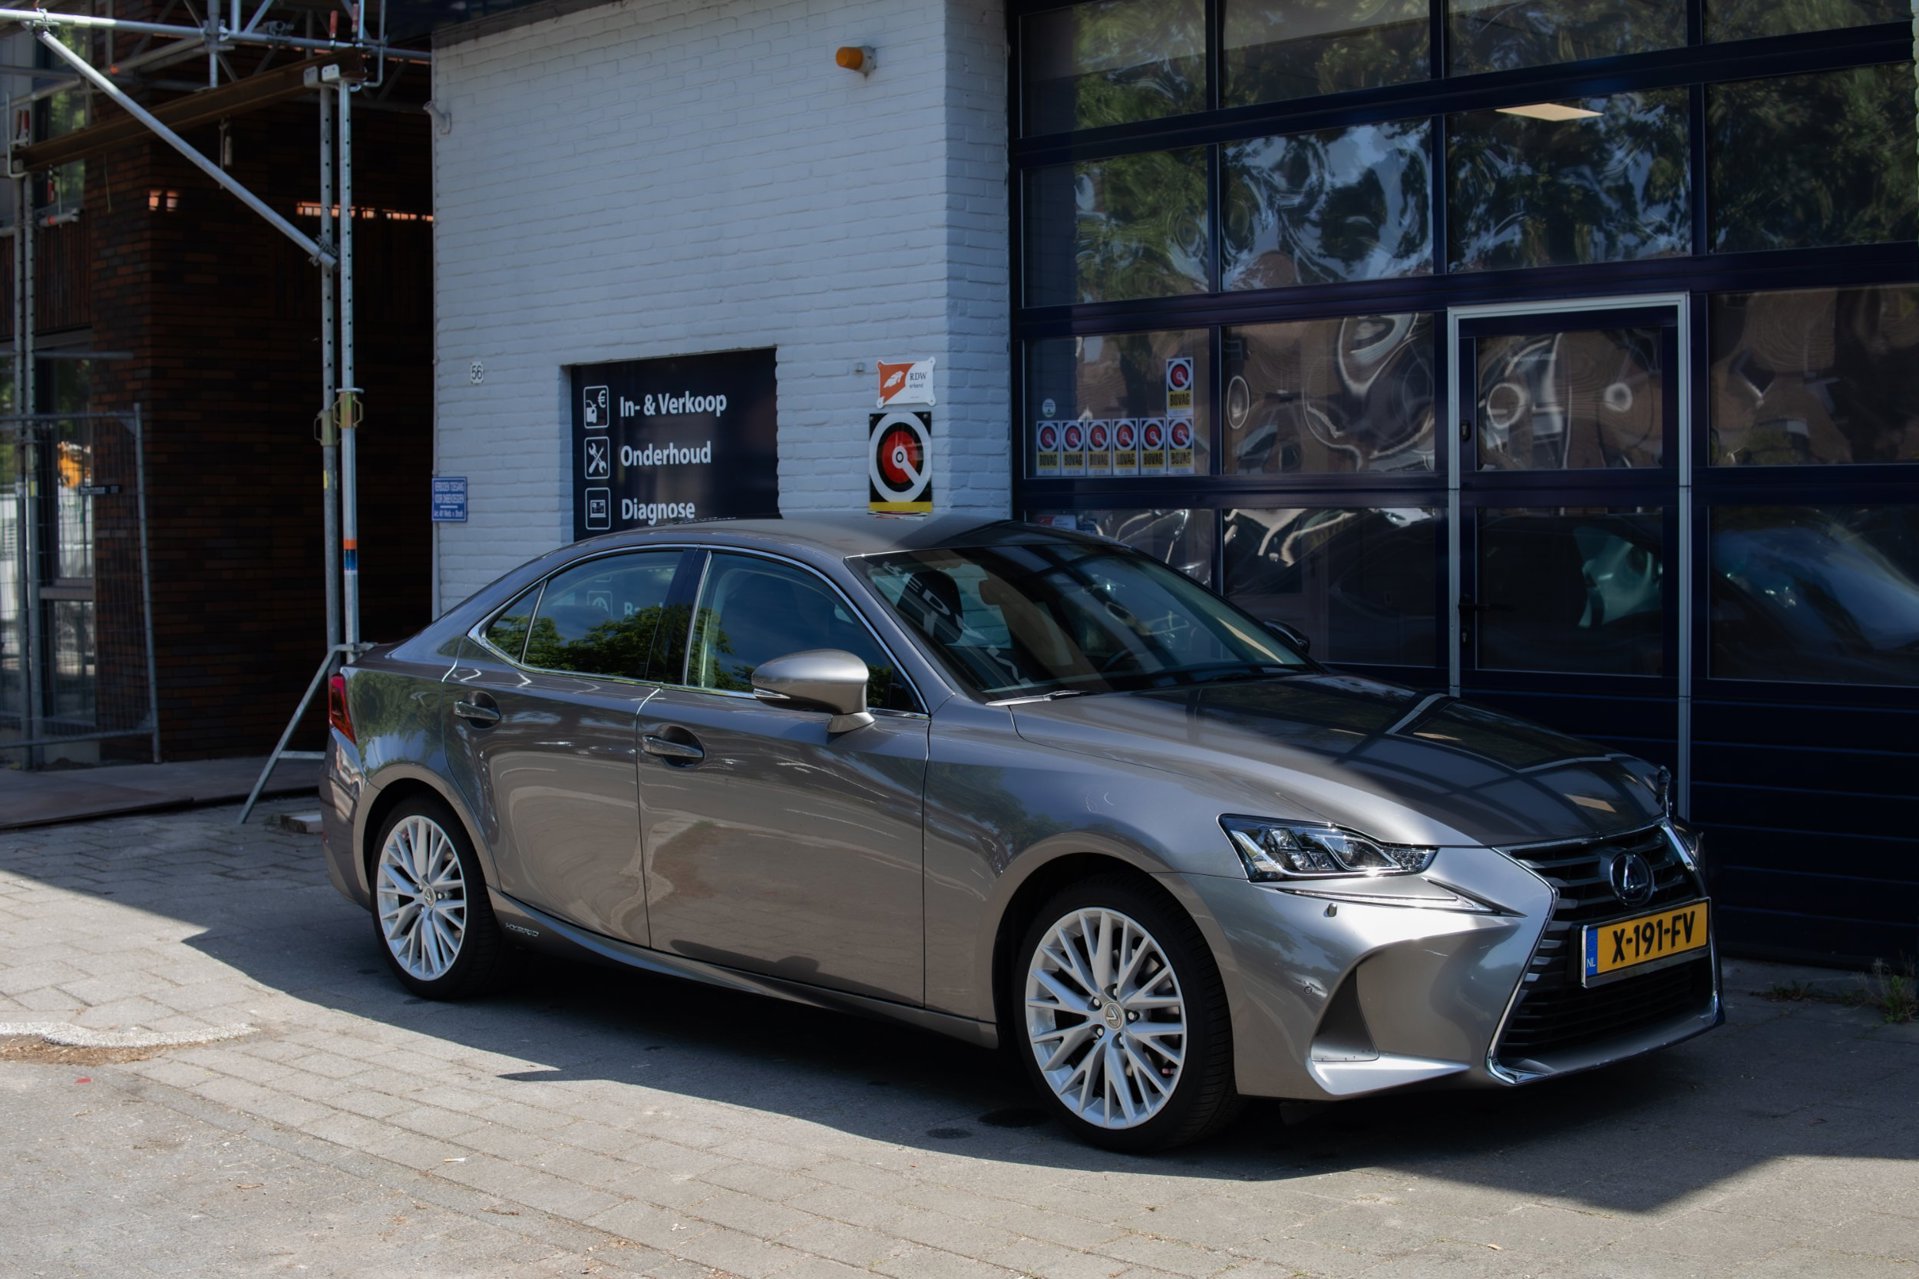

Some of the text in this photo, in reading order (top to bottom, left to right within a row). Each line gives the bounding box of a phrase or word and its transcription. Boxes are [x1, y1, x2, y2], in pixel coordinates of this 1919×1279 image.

[471, 364, 483, 380] 56
[620, 390, 727, 418] In- & Verkoop
[1170, 393, 1190, 406] BOVAG
[620, 440, 712, 467] Onderhoud
[621, 498, 696, 525] Diagnose
[1612, 911, 1696, 964] X-191-FV
[1586, 958, 1597, 969] NL
